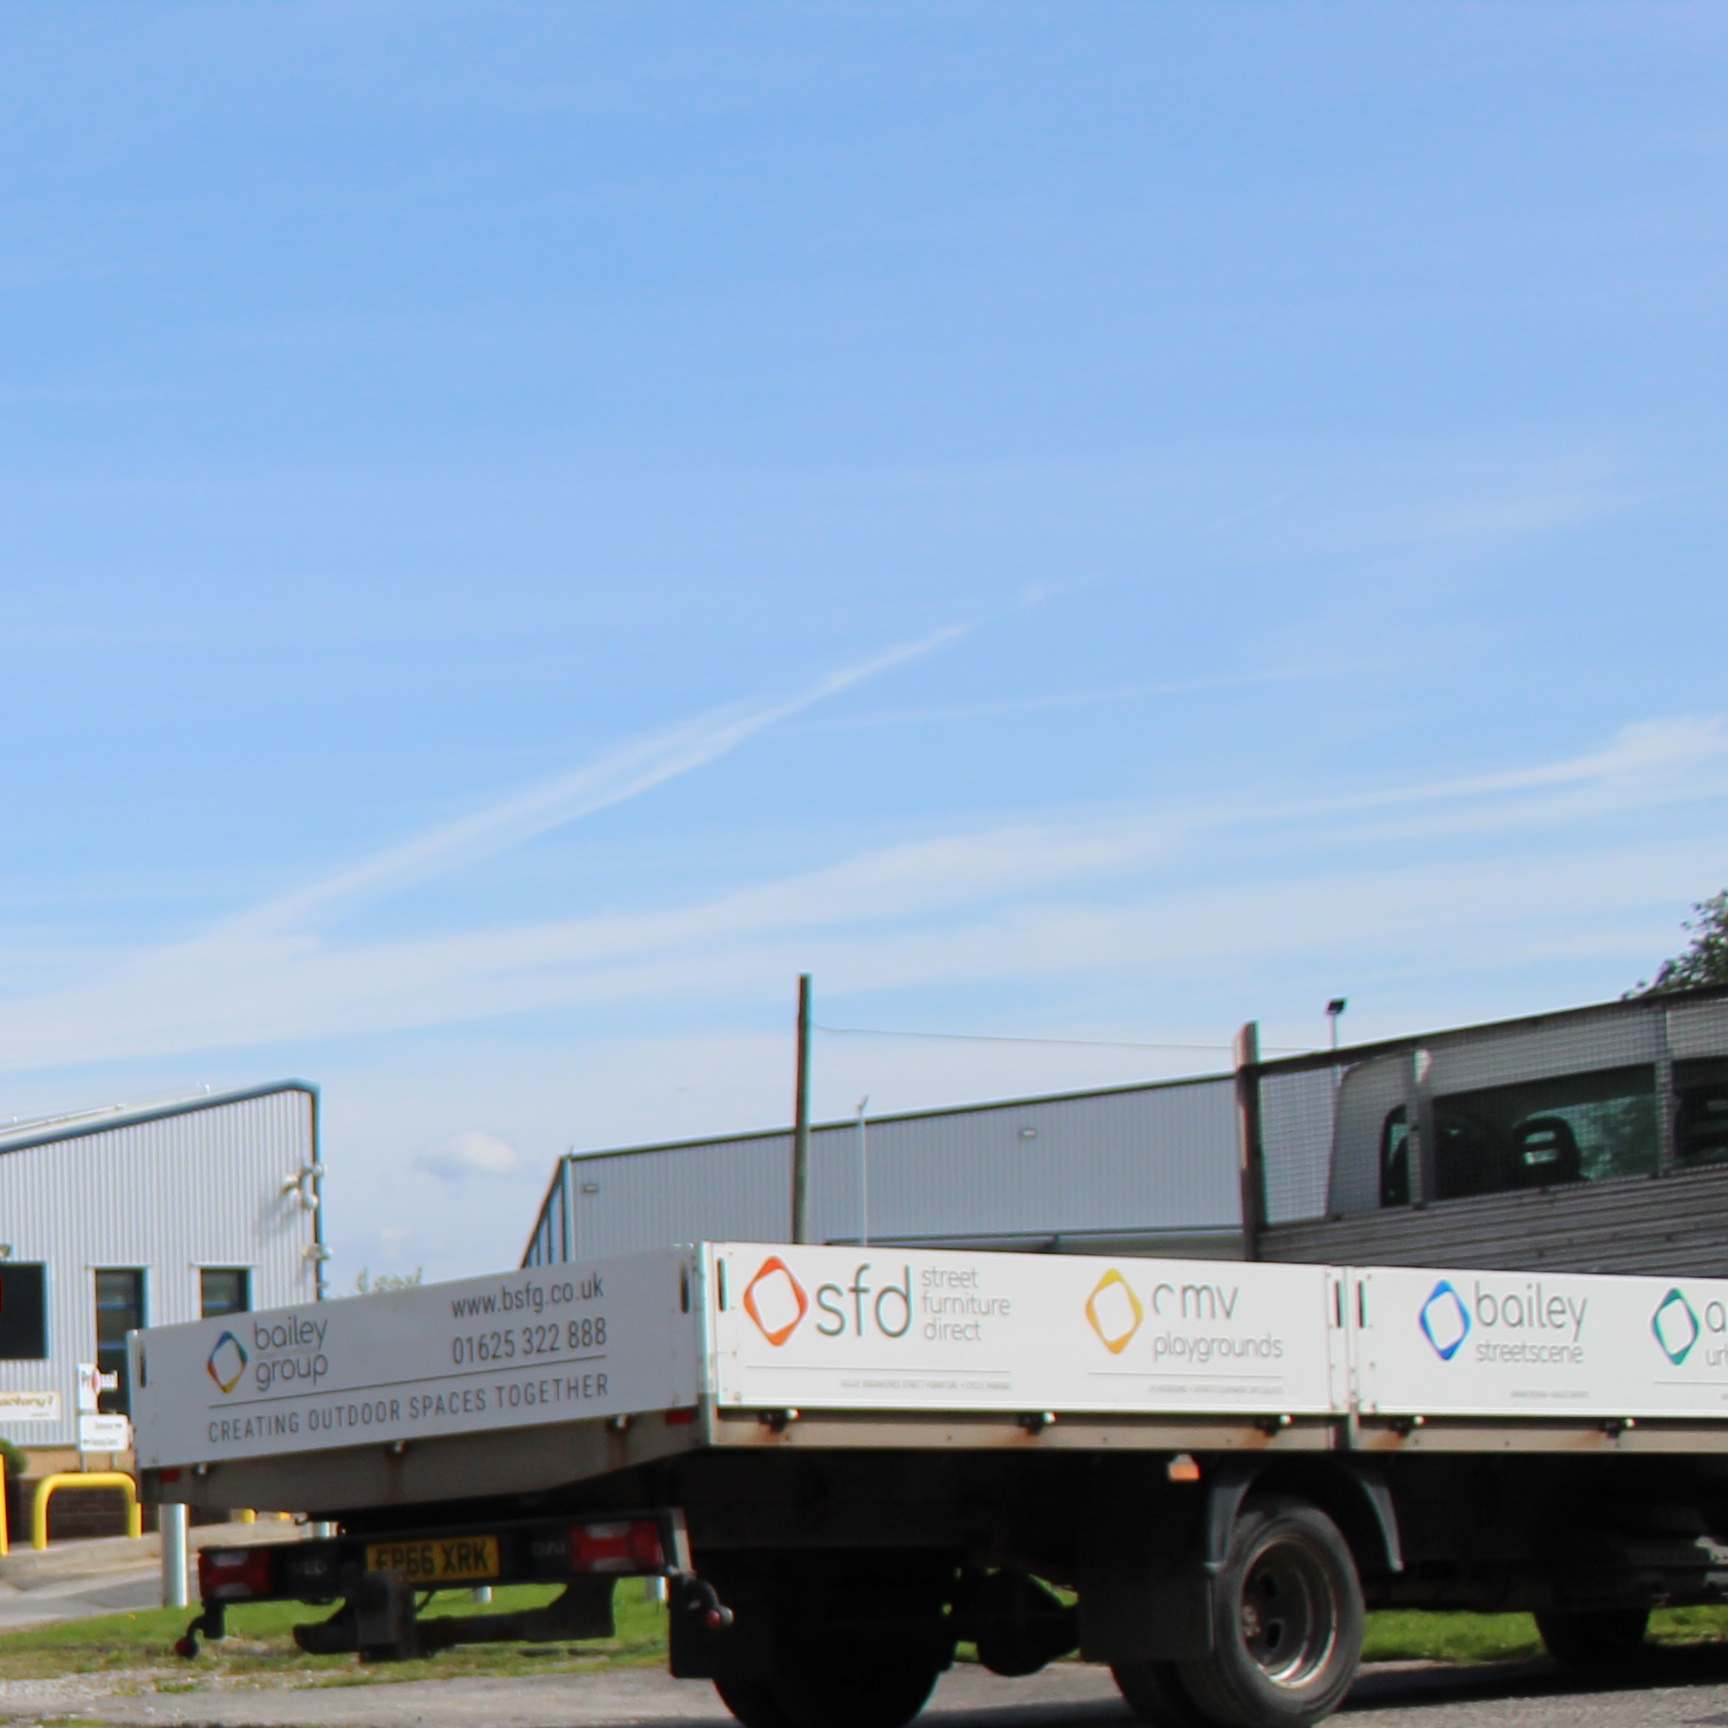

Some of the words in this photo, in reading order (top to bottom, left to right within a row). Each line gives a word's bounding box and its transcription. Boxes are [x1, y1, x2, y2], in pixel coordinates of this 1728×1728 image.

[451, 1270, 604, 1318] www.bsfg.co.uk
[922, 1267, 979, 1289] street
[815, 1262, 914, 1338] sfd
[922, 1291, 1011, 1316] furniture
[1473, 1279, 1588, 1342] bailey
[253, 1316, 328, 1352] bailey
[453, 1329, 515, 1365] 01625
[522, 1324, 561, 1356] 322
[568, 1317, 607, 1350] 888
[924, 1317, 983, 1341] direct
[1153, 1330, 1284, 1363] playgrounds
[1475, 1341, 1584, 1364] streetscene
[255, 1353, 329, 1391] group
[208, 1409, 300, 1443] CREATING
[308, 1401, 401, 1432] OUTDOOR
[410, 1388, 487, 1420] SPACES
[496, 1373, 609, 1409] TOGETHER
[443, 1540, 491, 1573] XRK
